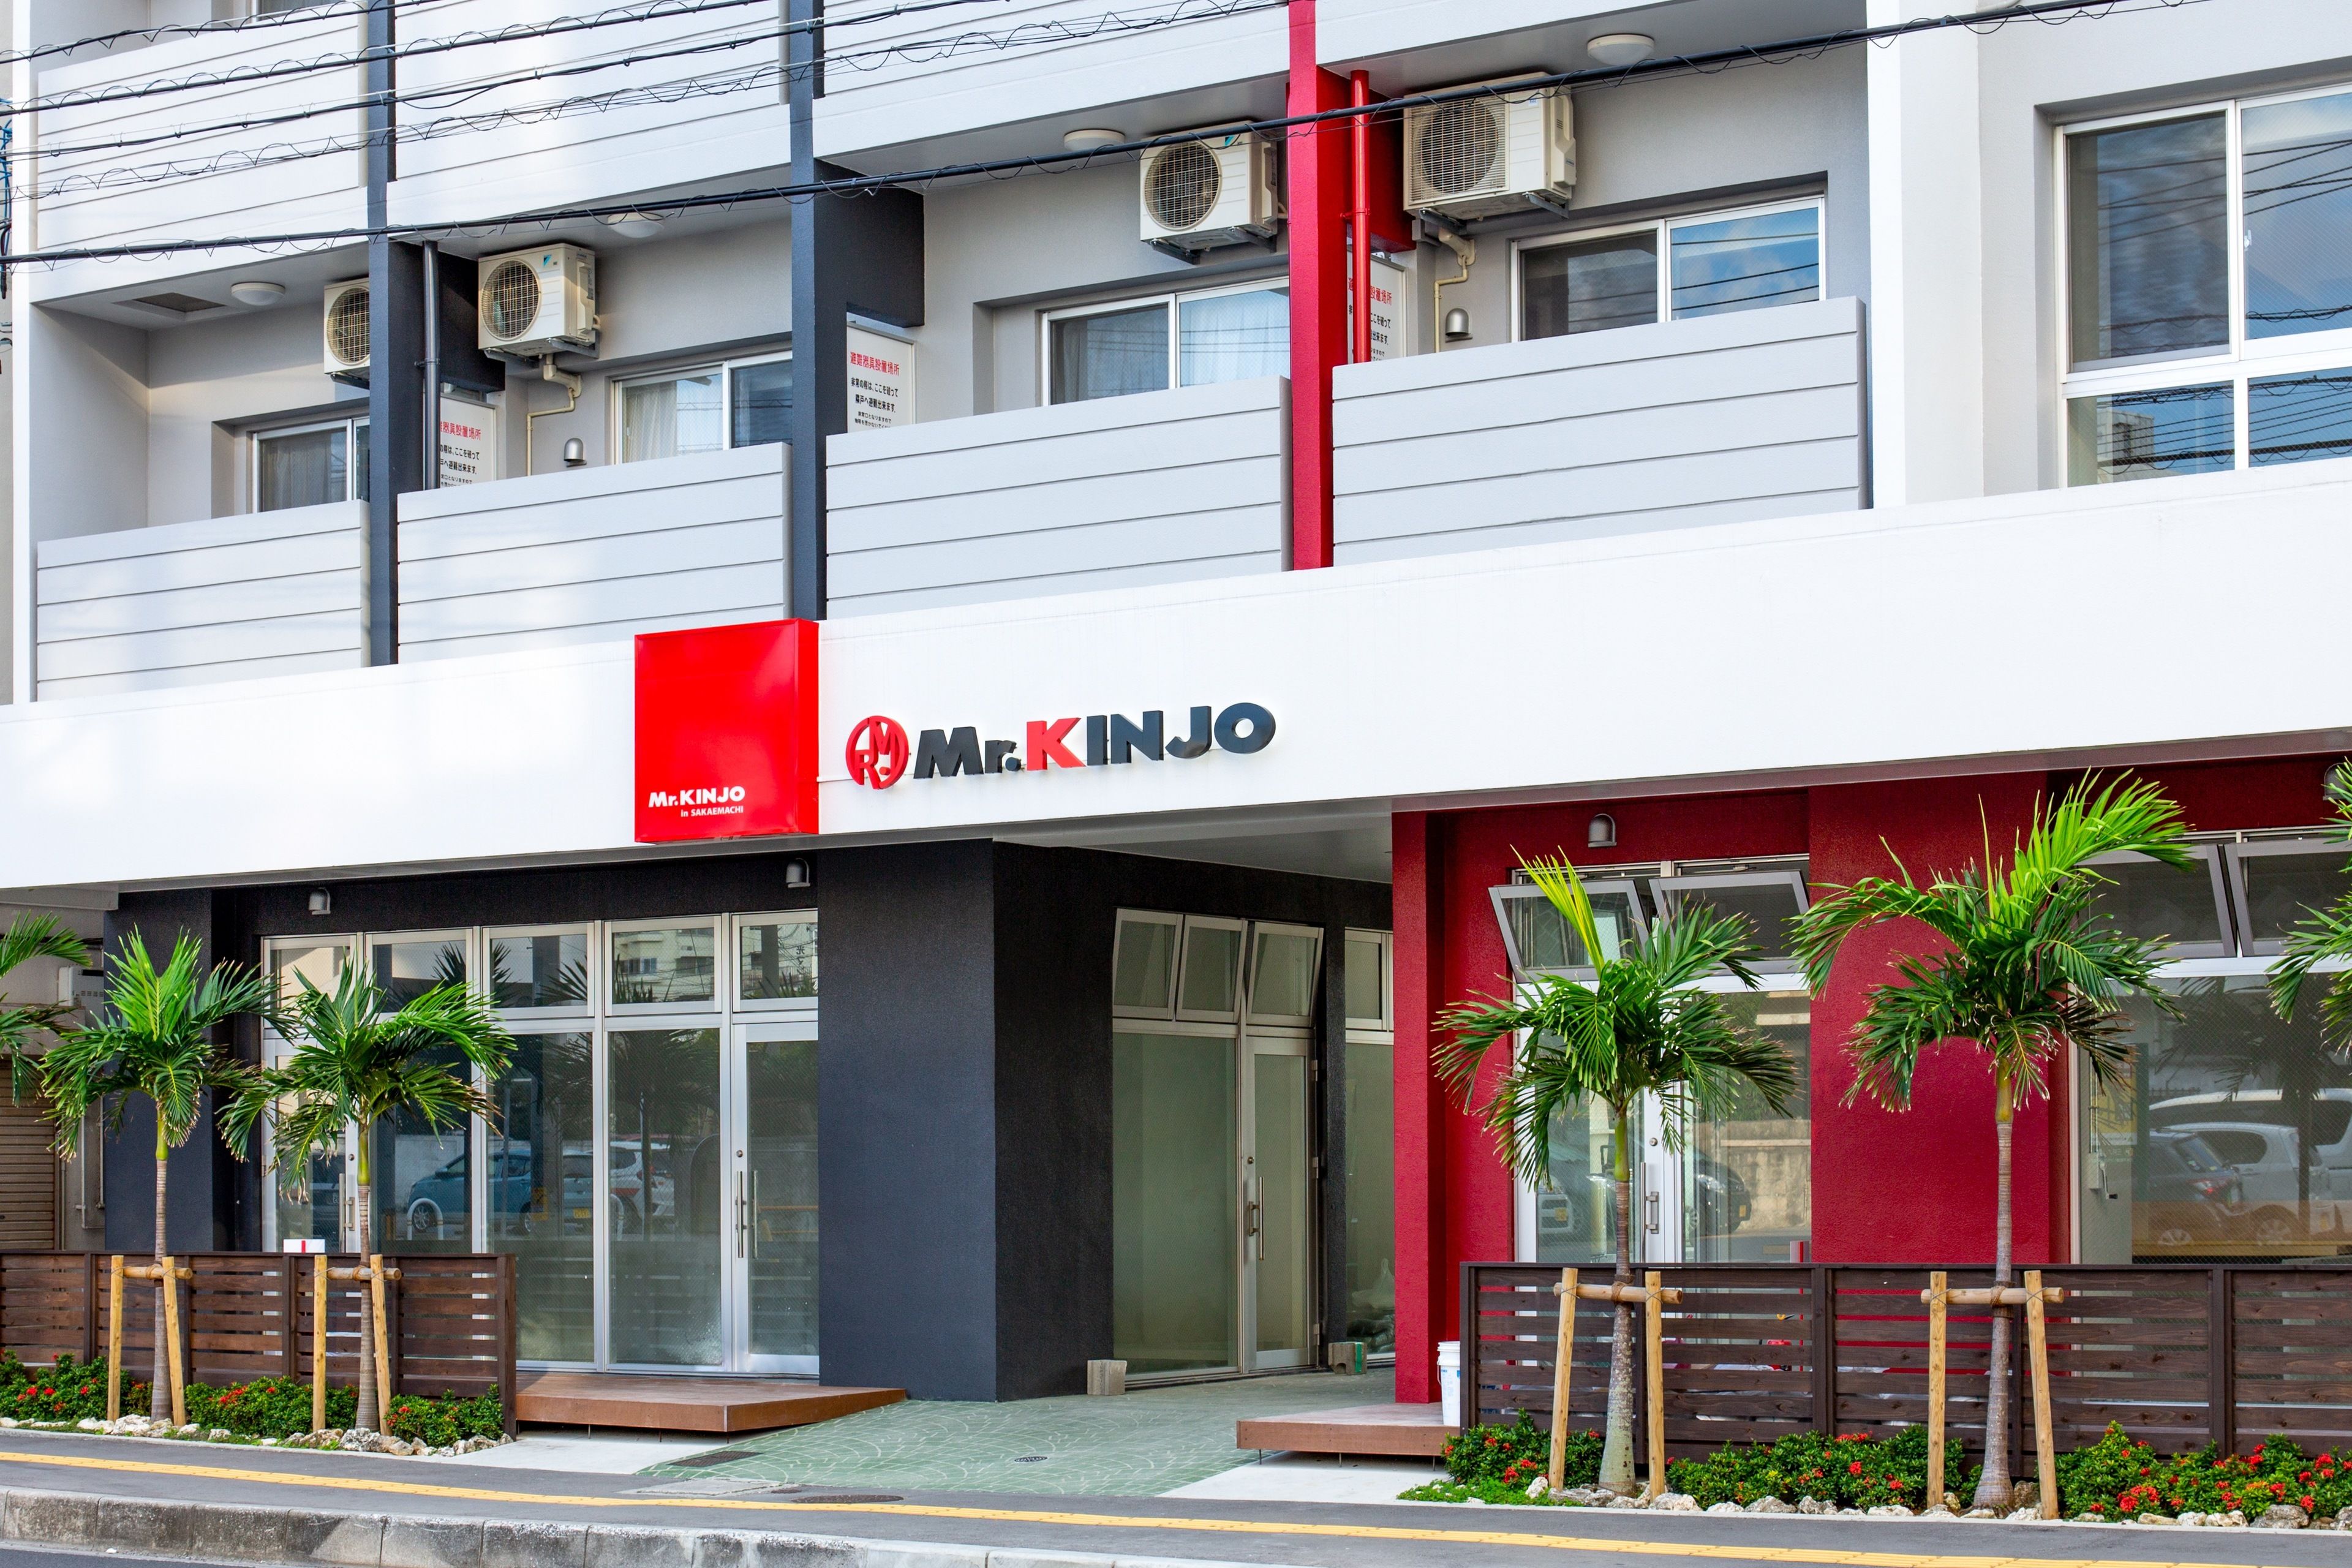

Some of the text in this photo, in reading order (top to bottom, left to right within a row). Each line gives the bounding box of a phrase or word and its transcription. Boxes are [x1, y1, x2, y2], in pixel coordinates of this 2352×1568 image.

[913, 702, 1276, 779] Mr.KINJO
[648, 786, 745, 808] Mr.KINJO
[680, 805, 744, 818] in SAKAEMACHI
